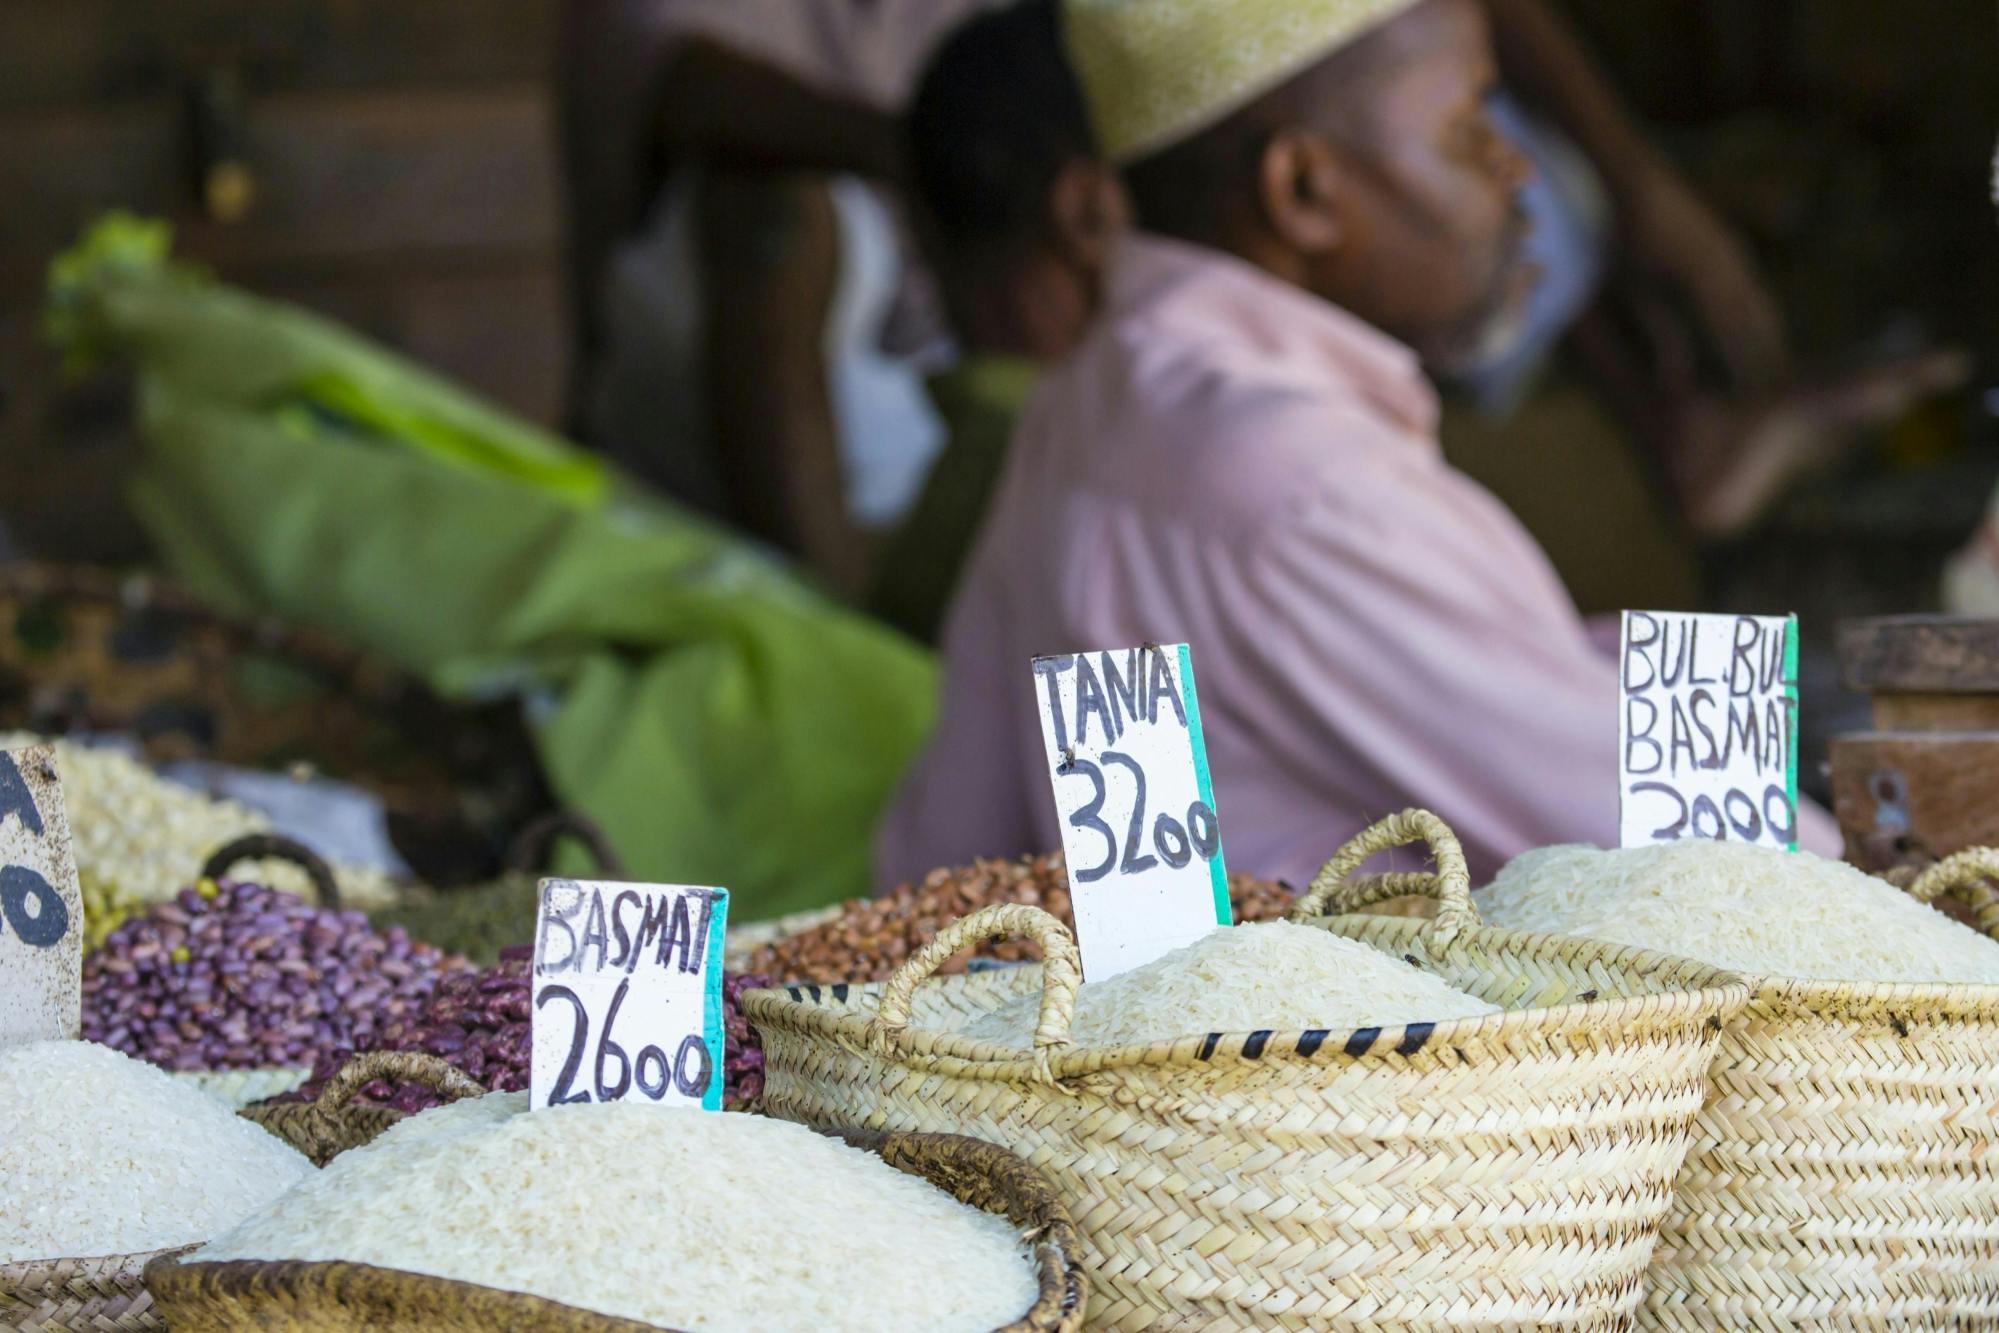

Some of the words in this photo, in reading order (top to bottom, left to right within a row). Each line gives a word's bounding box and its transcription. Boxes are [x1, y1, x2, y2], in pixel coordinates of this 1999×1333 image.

[1032, 647, 1187, 752] TANIA
[1626, 688, 1797, 778] BASMAT
[1056, 751, 1219, 882] 3200
[1630, 781, 1797, 844] 2000
[536, 879, 727, 976] BASMAT
[536, 976, 712, 1107] 2600
